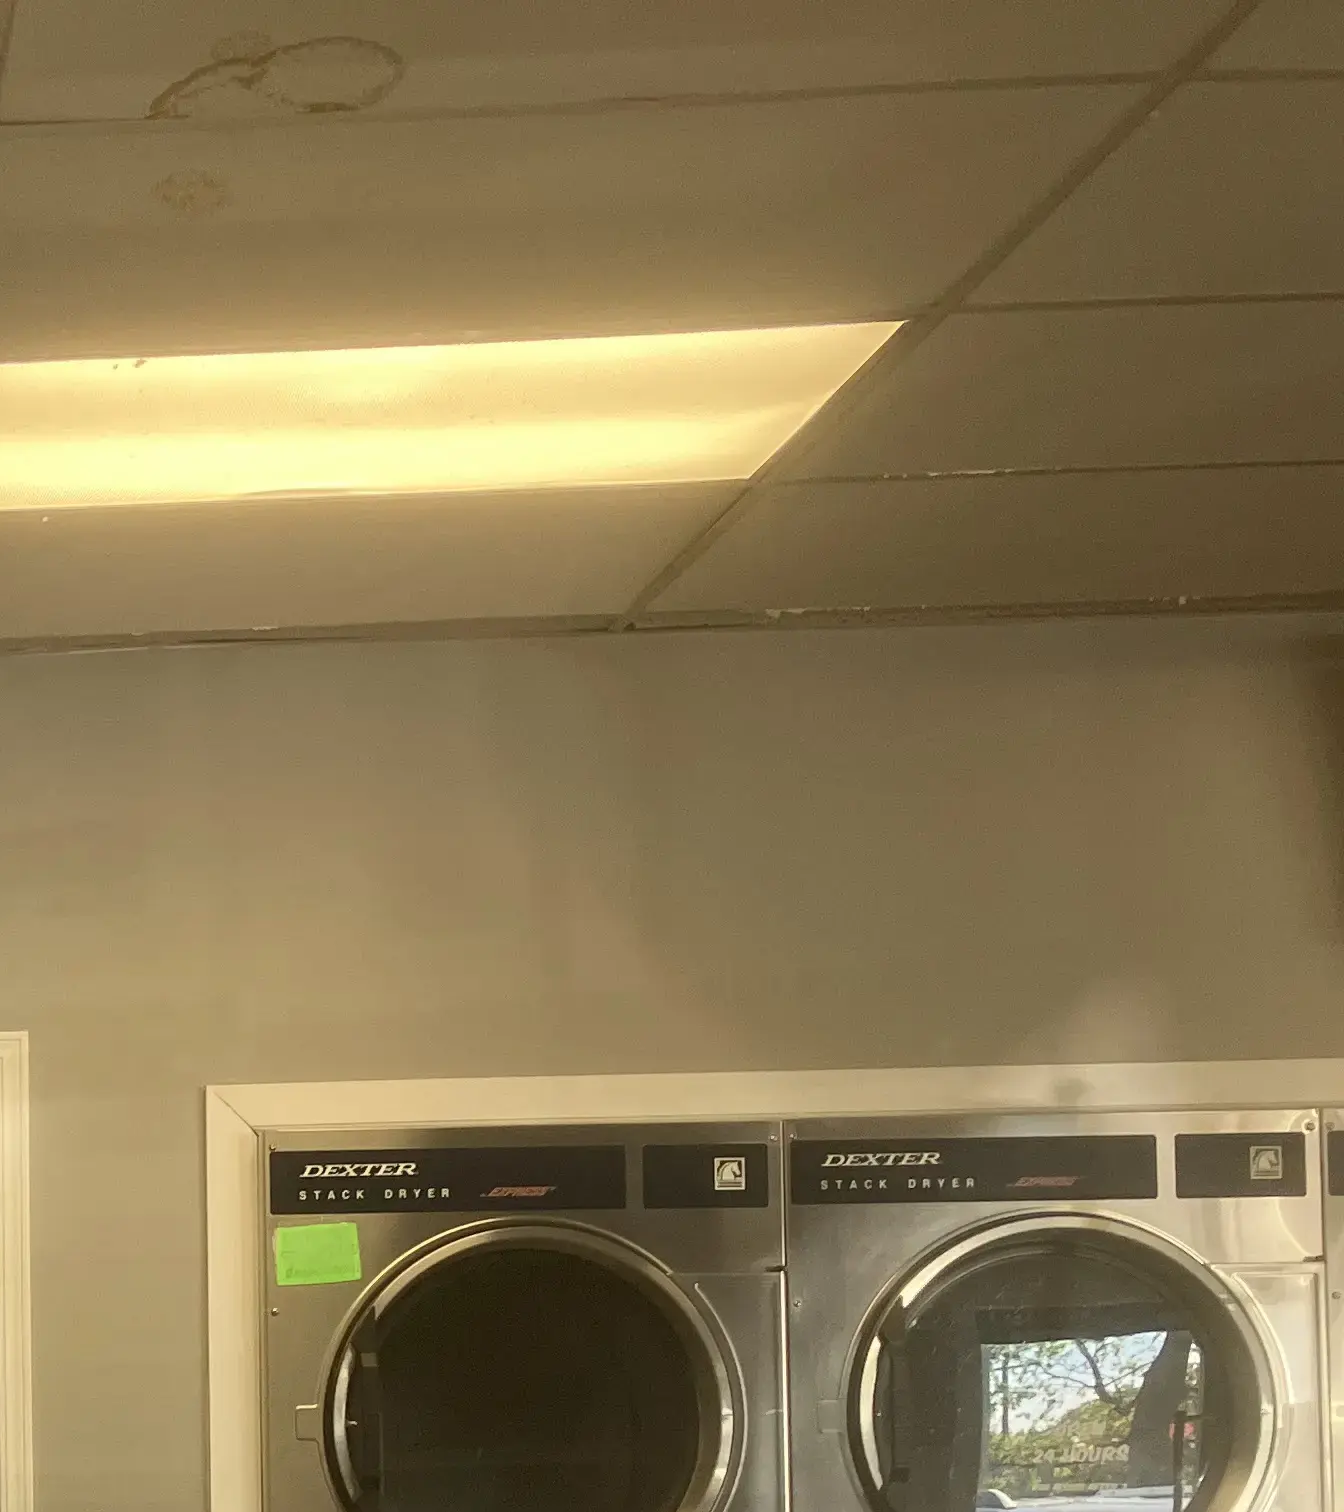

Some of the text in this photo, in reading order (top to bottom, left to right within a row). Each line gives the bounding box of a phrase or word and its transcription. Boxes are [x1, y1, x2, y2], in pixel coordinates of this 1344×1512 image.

[820, 1151, 941, 1167] DEXTER
[298, 1162, 419, 1179] DEXTER
[819, 1178, 890, 1191] STACK
[907, 1177, 977, 1189] DRYER
[297, 1188, 366, 1202] STACK
[384, 1187, 452, 1201] DRYER
[1032, 1448, 1056, 1464] 24
